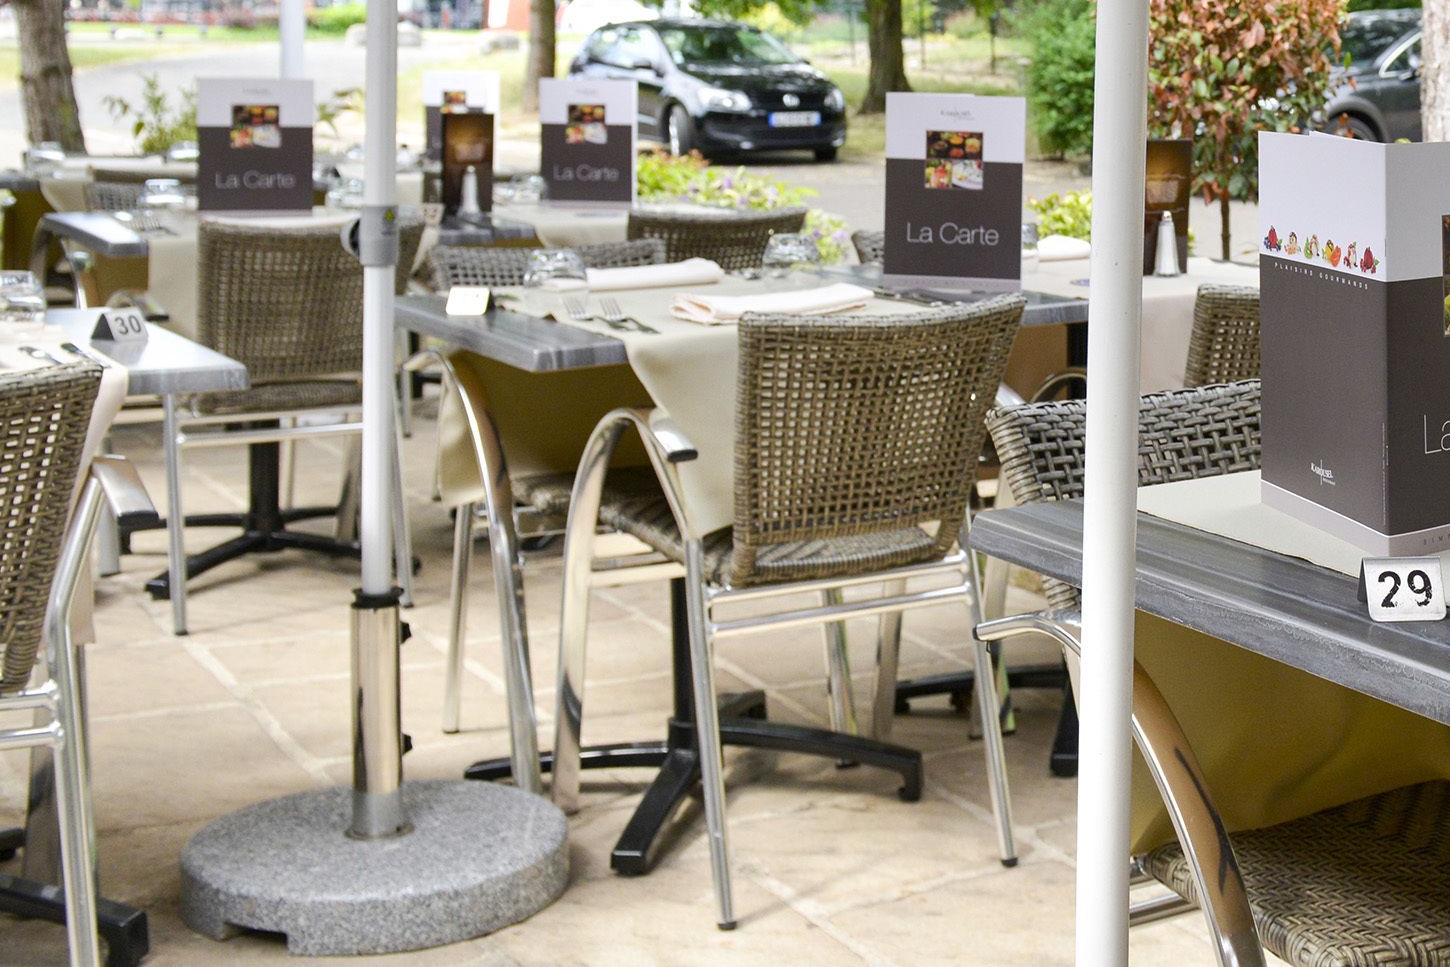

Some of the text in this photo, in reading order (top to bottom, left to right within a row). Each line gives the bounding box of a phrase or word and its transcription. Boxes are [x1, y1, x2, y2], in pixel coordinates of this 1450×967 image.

[215, 170, 297, 189] La Carte
[553, 163, 620, 182] La Carte
[906, 222, 1000, 246] La Carte
[114, 314, 142, 336] 30
[1378, 569, 1434, 609] 29
